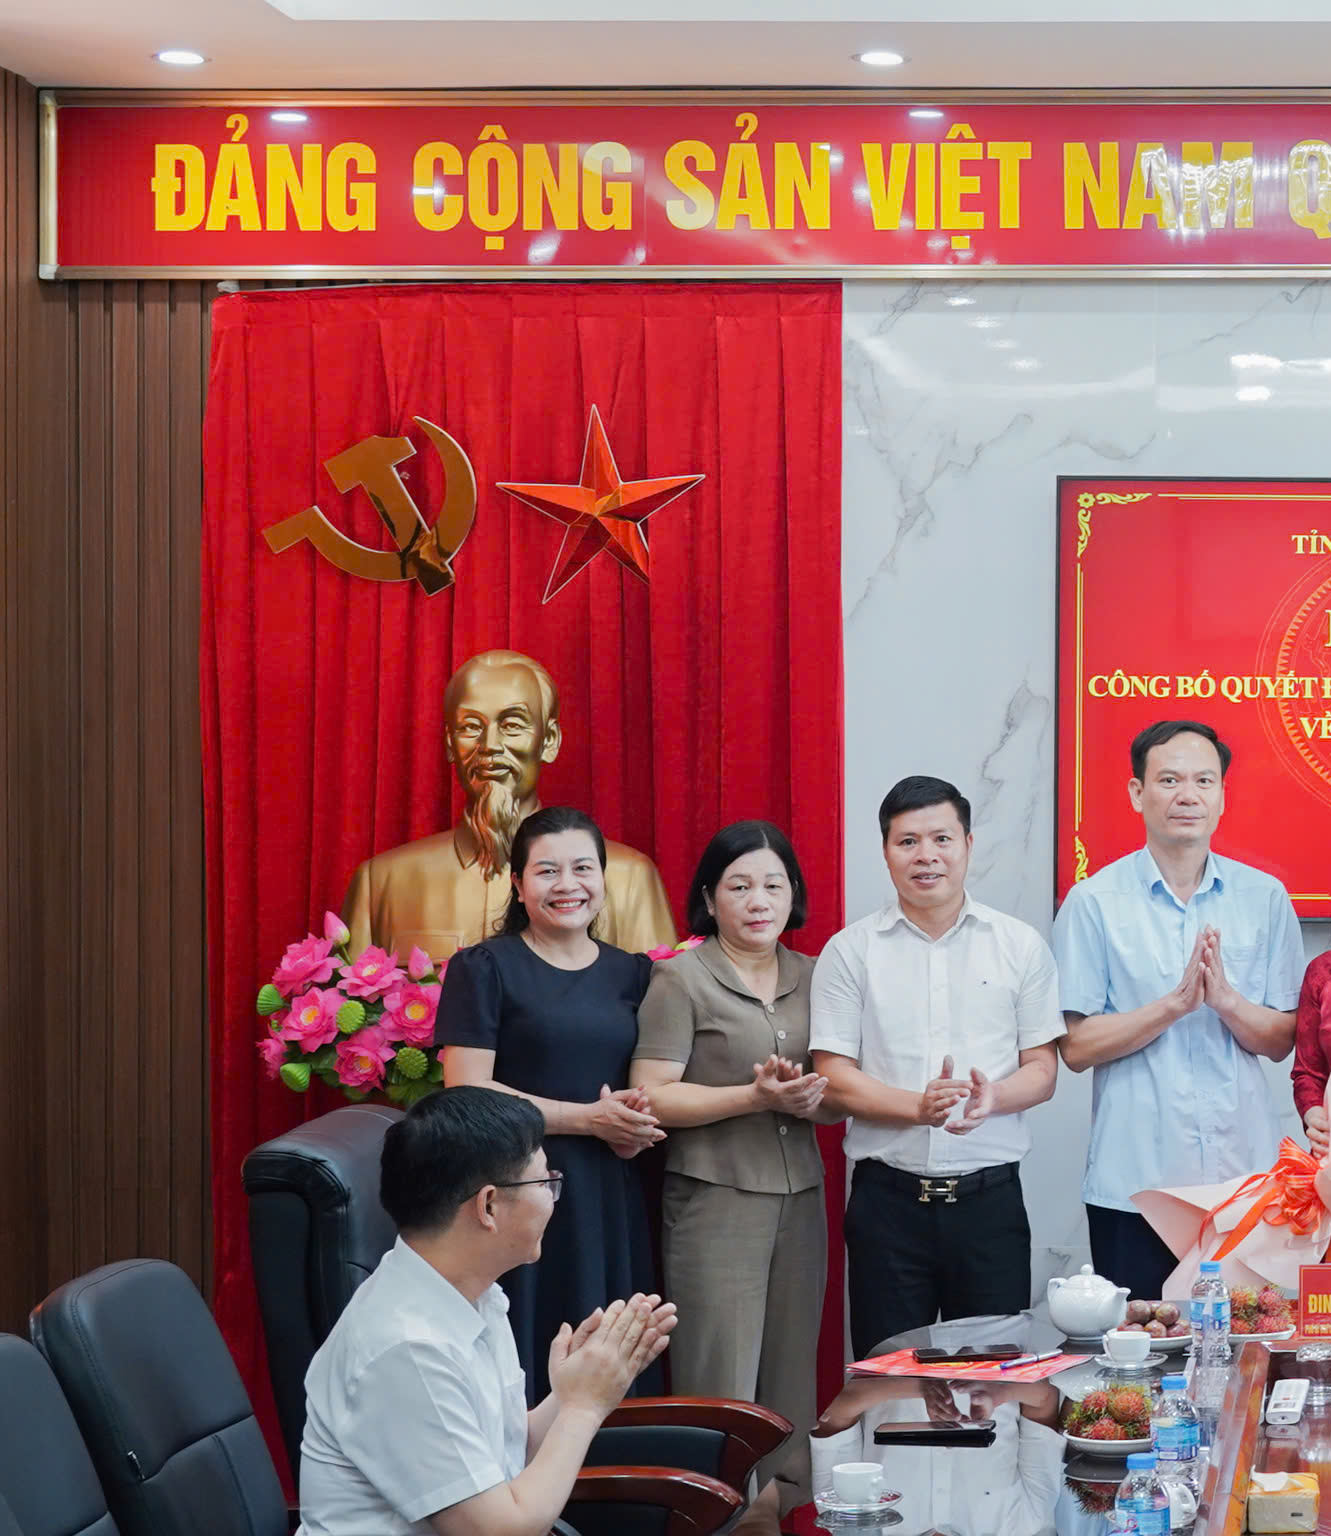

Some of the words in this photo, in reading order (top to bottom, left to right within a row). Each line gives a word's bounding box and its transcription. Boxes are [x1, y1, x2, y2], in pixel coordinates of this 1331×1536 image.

[151, 113, 377, 232] ĐẢNG
[412, 124, 633, 250] CỘNG
[665, 111, 833, 231] SẢN
[861, 123, 1031, 250] VIỆT
[1064, 141, 1253, 231] NAM
[1087, 669, 1171, 699] CÔNG
[1176, 669, 1217, 698] BỐ
[1220, 670, 1318, 703] QUYẾT
